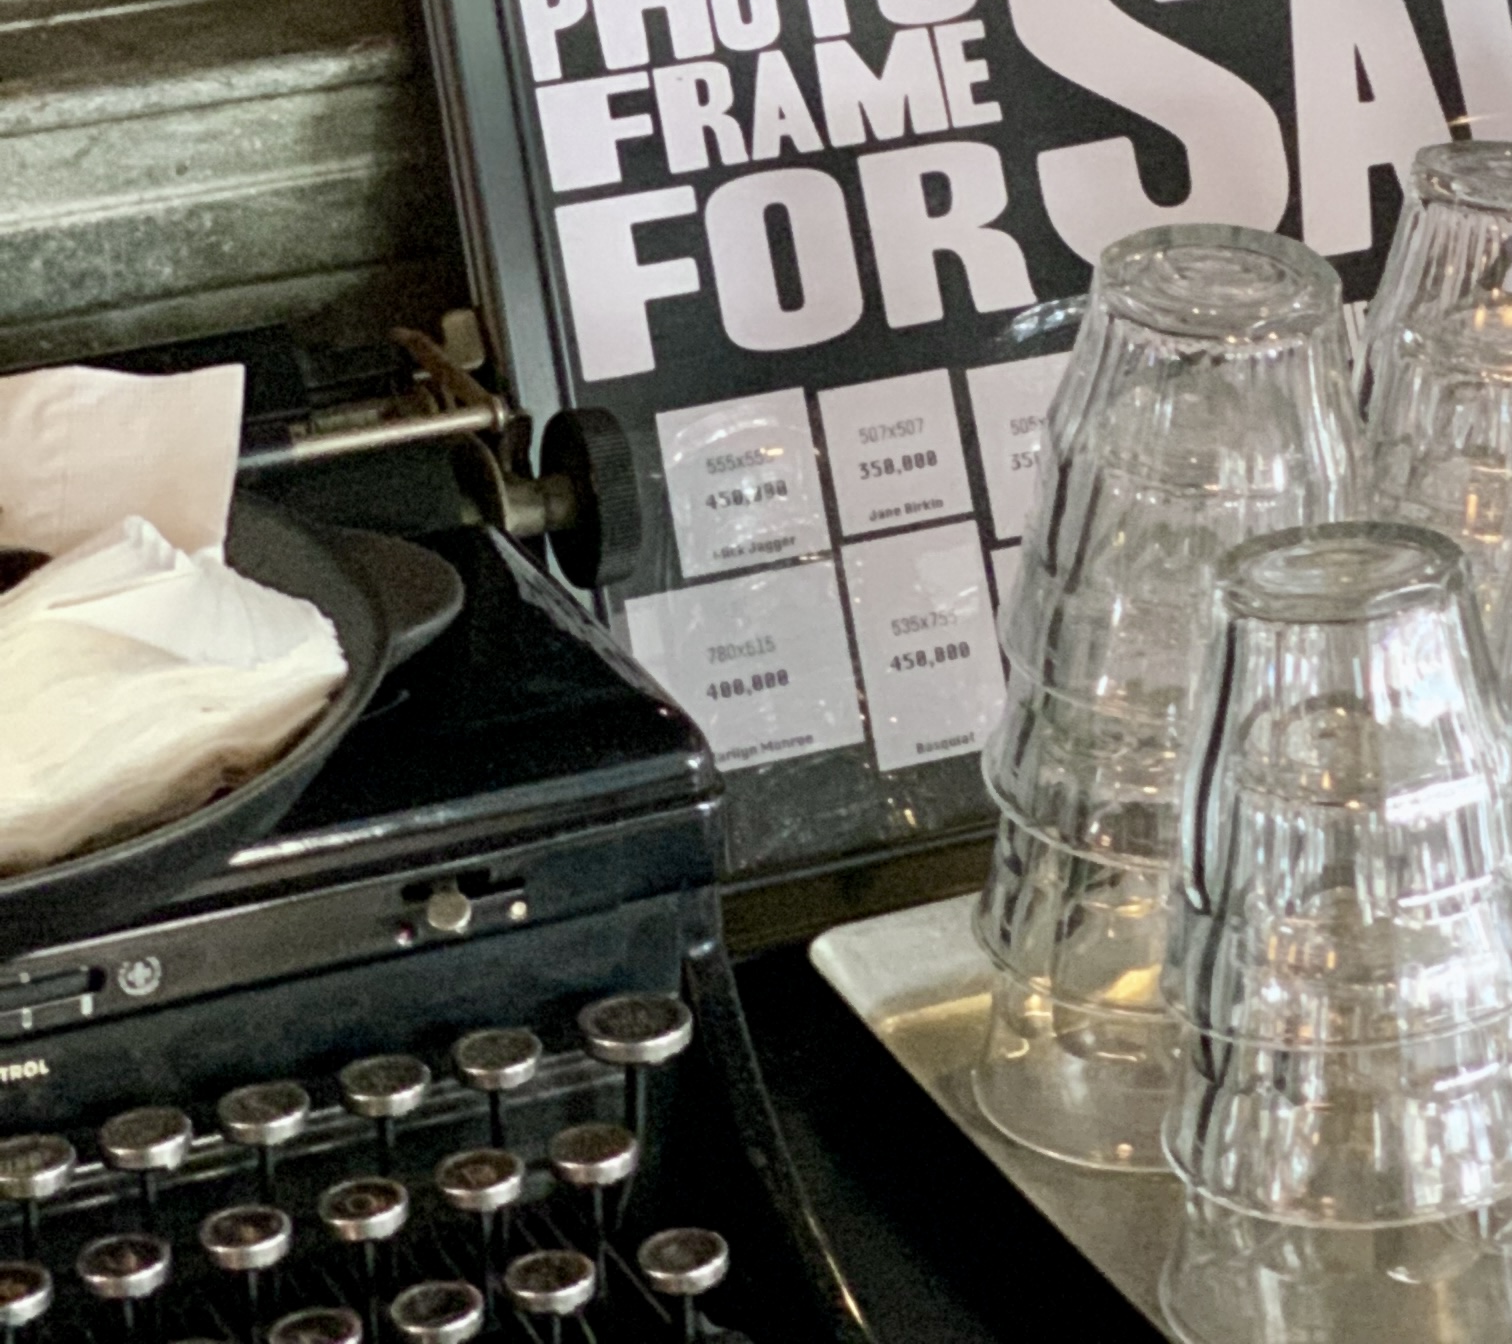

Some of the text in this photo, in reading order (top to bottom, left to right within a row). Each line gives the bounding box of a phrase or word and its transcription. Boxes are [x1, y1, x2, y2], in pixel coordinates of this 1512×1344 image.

[534, 19, 1004, 193] FRAME
[554, 140, 1038, 383] FOR
[858, 417, 925, 445] 507x507
[858, 450, 938, 480] 350,000
[868, 499, 945, 522] Jane Birkin
[748, 536, 796, 555] Jagger
[890, 641, 971, 673] 450,000
[706, 668, 790, 701] 400,000
[715, 733, 814, 762] arilyn Monroe
[916, 731, 976, 755] Basquiat
